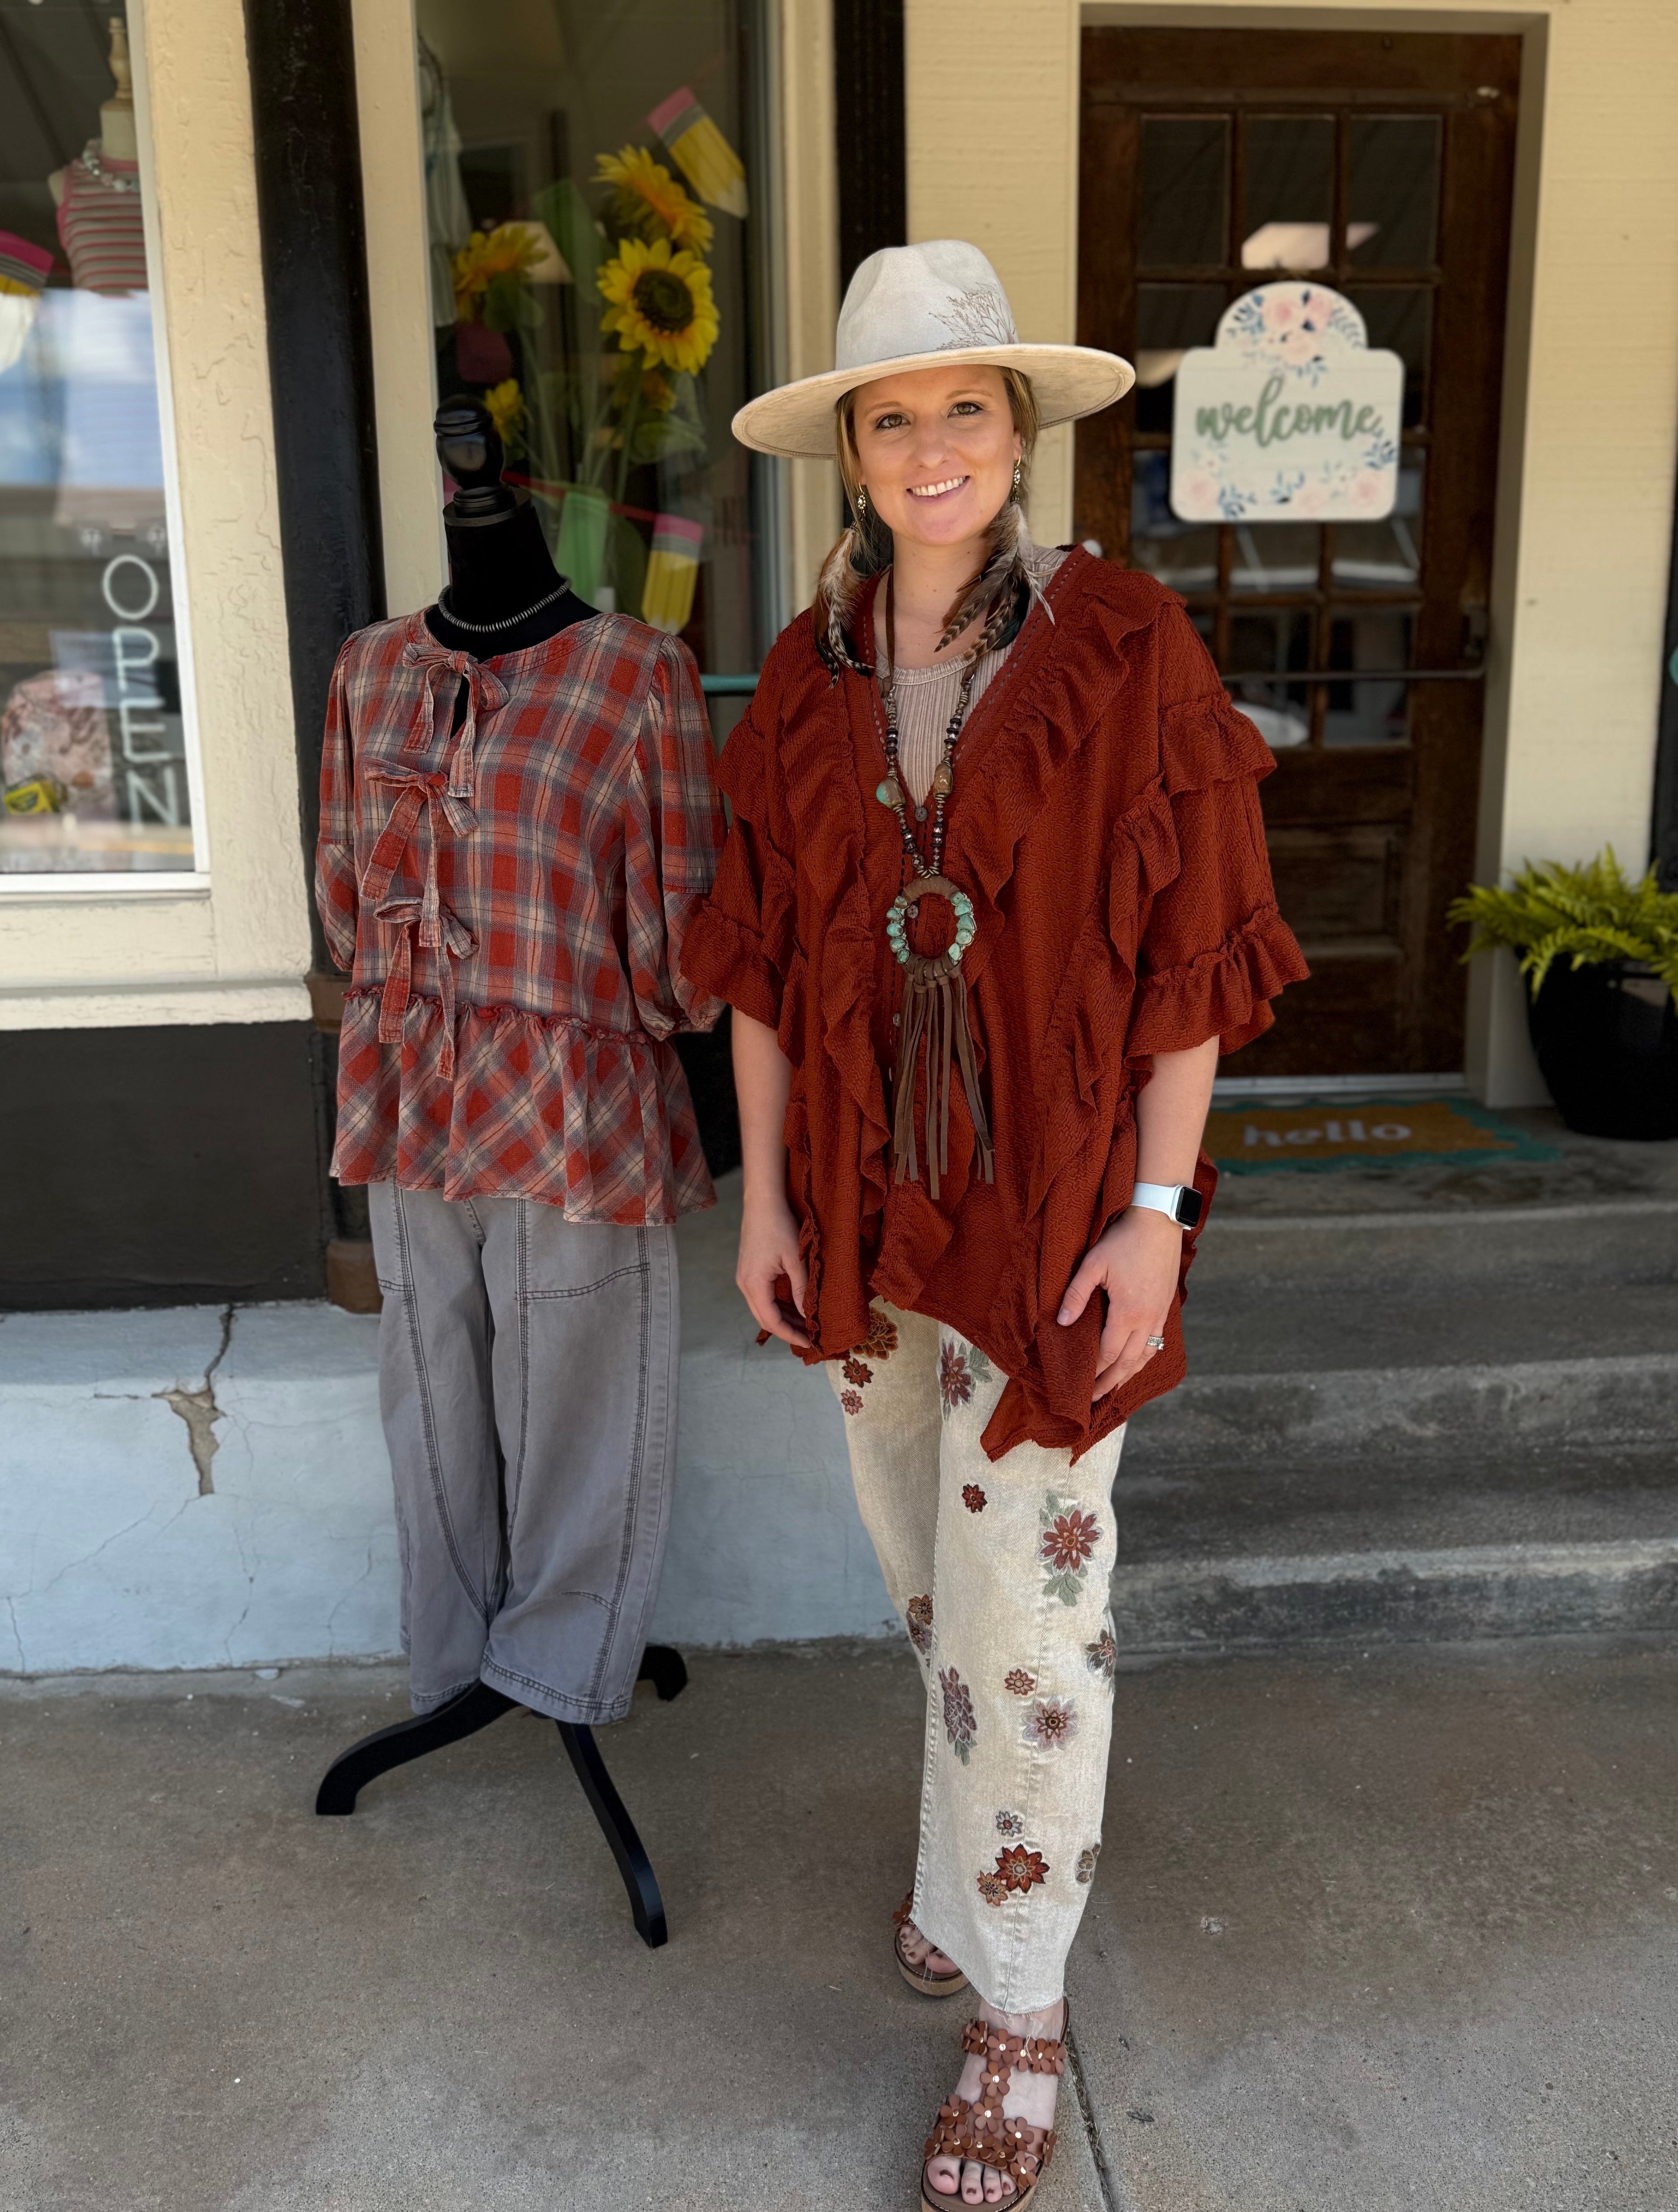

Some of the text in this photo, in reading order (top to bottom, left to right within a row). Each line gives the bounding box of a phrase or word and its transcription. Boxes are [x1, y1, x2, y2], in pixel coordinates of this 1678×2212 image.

[1196, 375, 1382, 447] welcome
[102, 554, 178, 835] OPEN
[1242, 1120, 1412, 1147] hello
